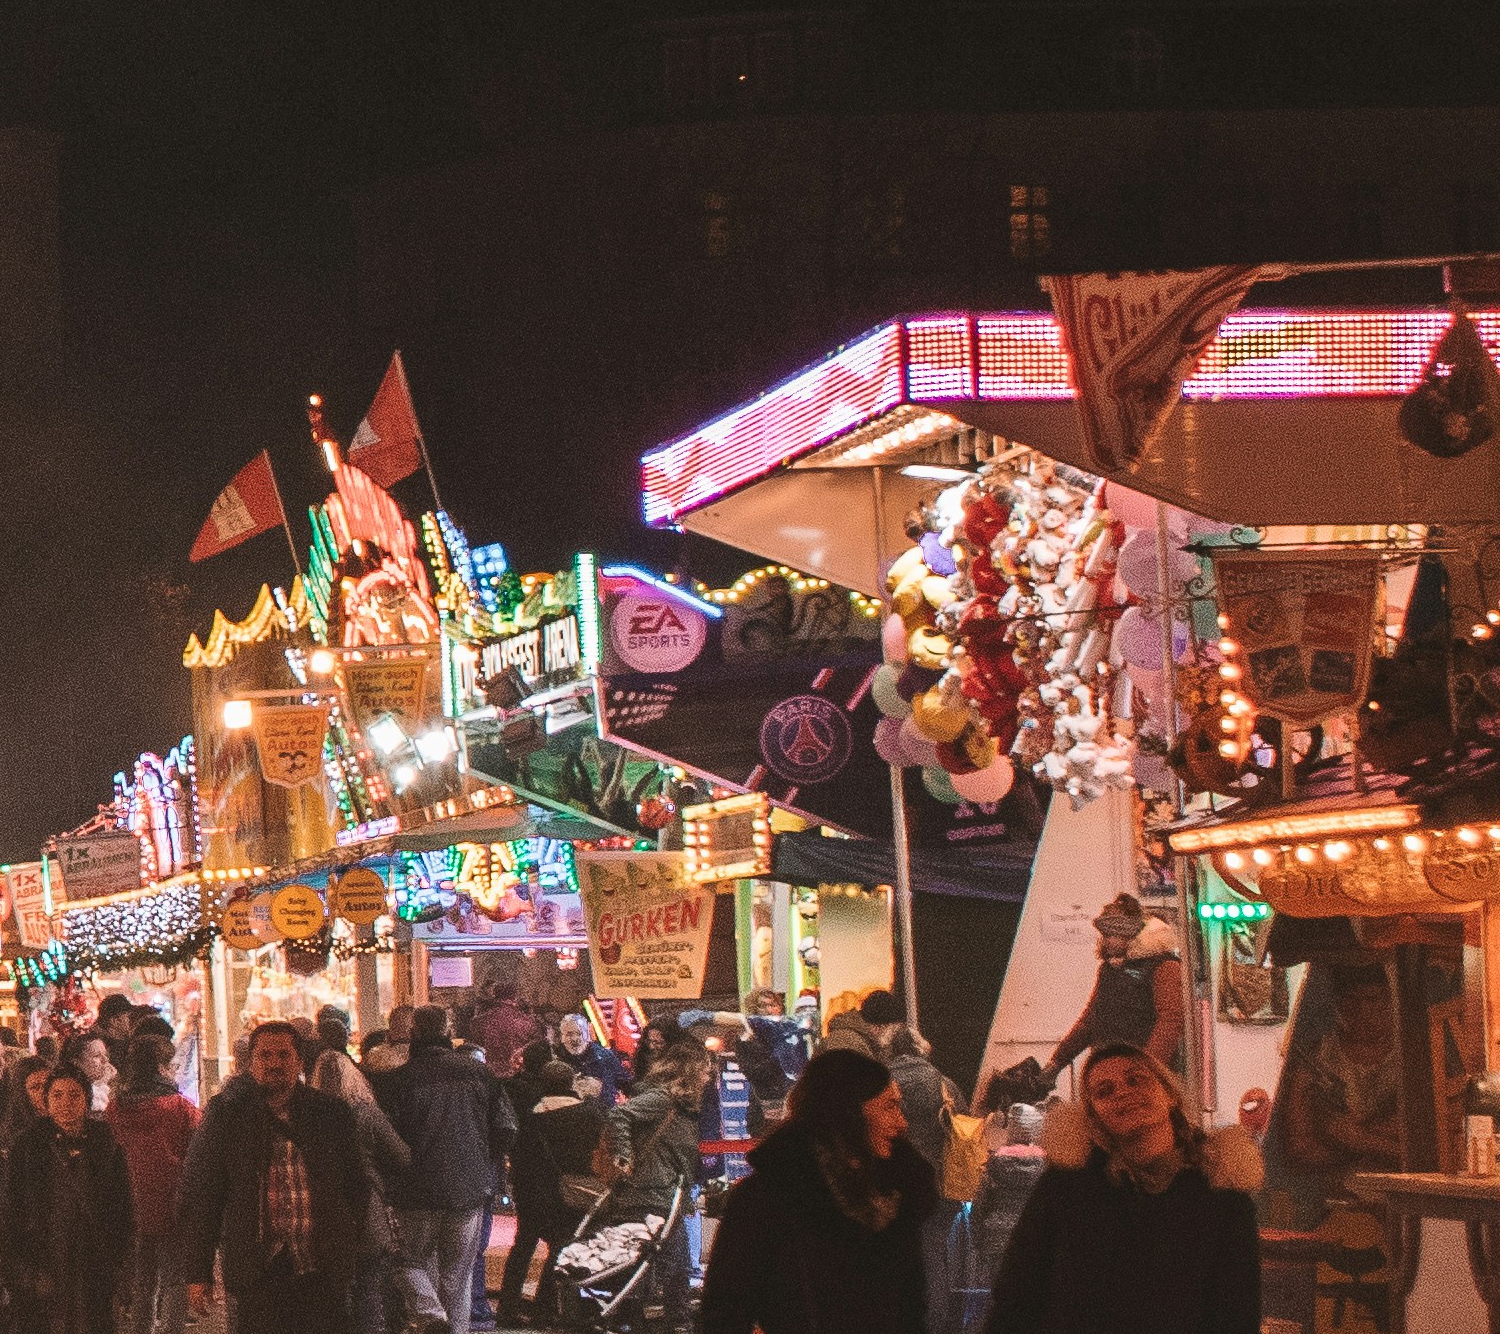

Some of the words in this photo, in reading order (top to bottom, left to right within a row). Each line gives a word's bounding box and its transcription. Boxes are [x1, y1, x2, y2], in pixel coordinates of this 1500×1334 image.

[629, 604, 687, 635] EA
[627, 634, 691, 650] SPORTS
[360, 695, 416, 708] Autos
[773, 700, 833, 724] PARIS
[267, 739, 318, 752] Autos
[13, 873, 38, 887] 1x
[598, 896, 702, 947] GURKEN
